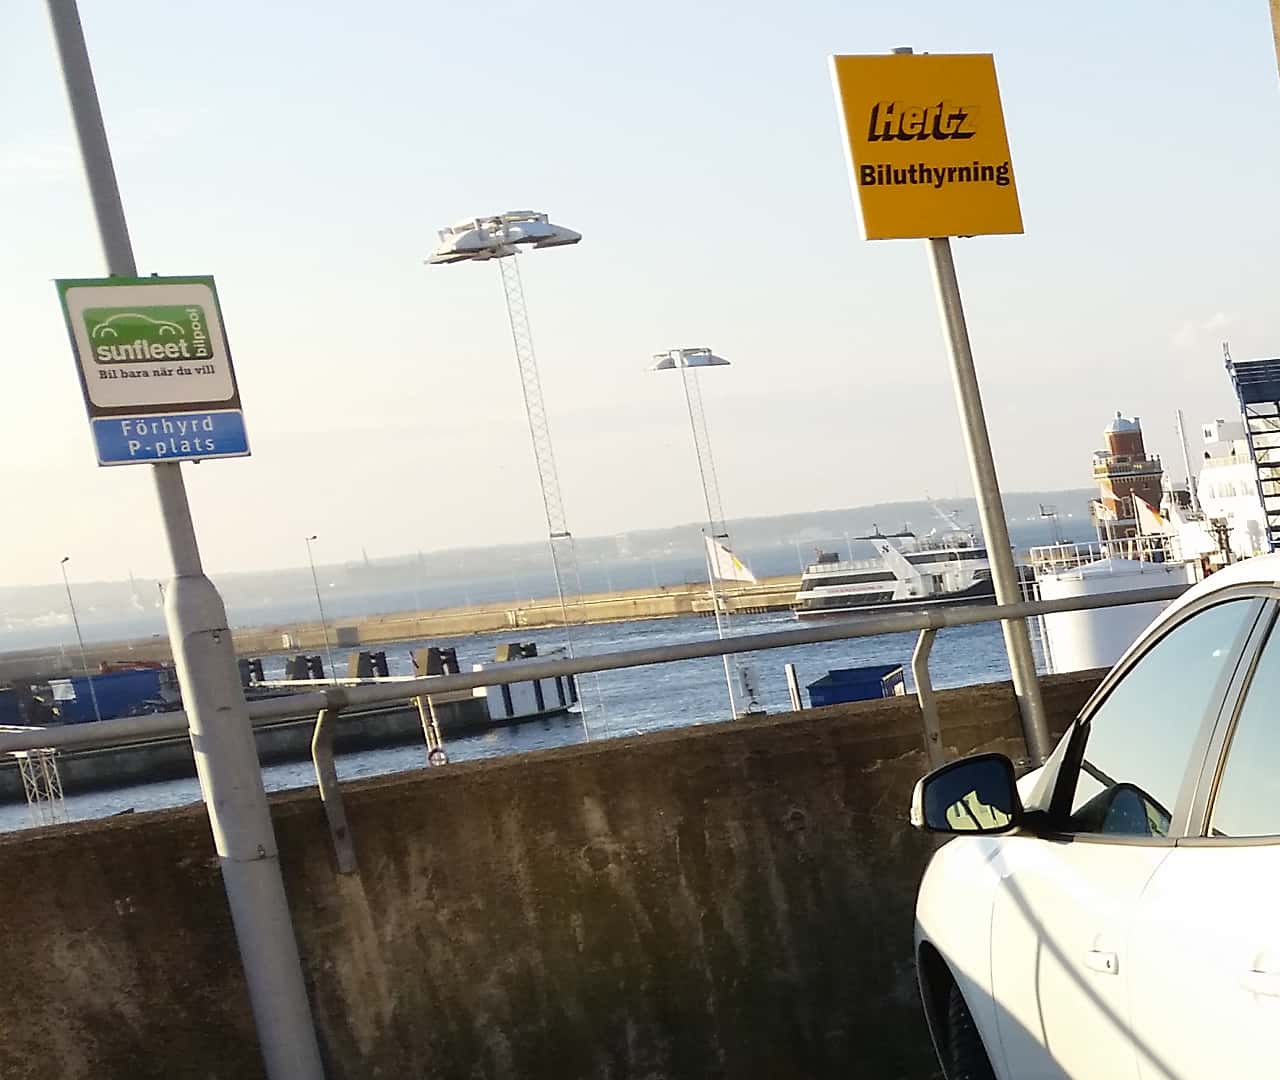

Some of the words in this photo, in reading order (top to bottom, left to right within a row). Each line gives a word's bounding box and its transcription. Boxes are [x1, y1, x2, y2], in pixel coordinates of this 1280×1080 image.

[866, 101, 980, 142] Hertz
[859, 161, 1010, 188] Biluthyrning
[186, 308, 208, 357] bilpool
[97, 339, 190, 361] sunfleet
[98, 369, 118, 379] Bil
[120, 368, 149, 379] bara
[153, 367, 173, 377] när
[176, 365, 192, 375] du
[194, 364, 215, 374] vill
[121, 415, 213, 436] Förhyrd
[128, 437, 215, 457] P-plats
